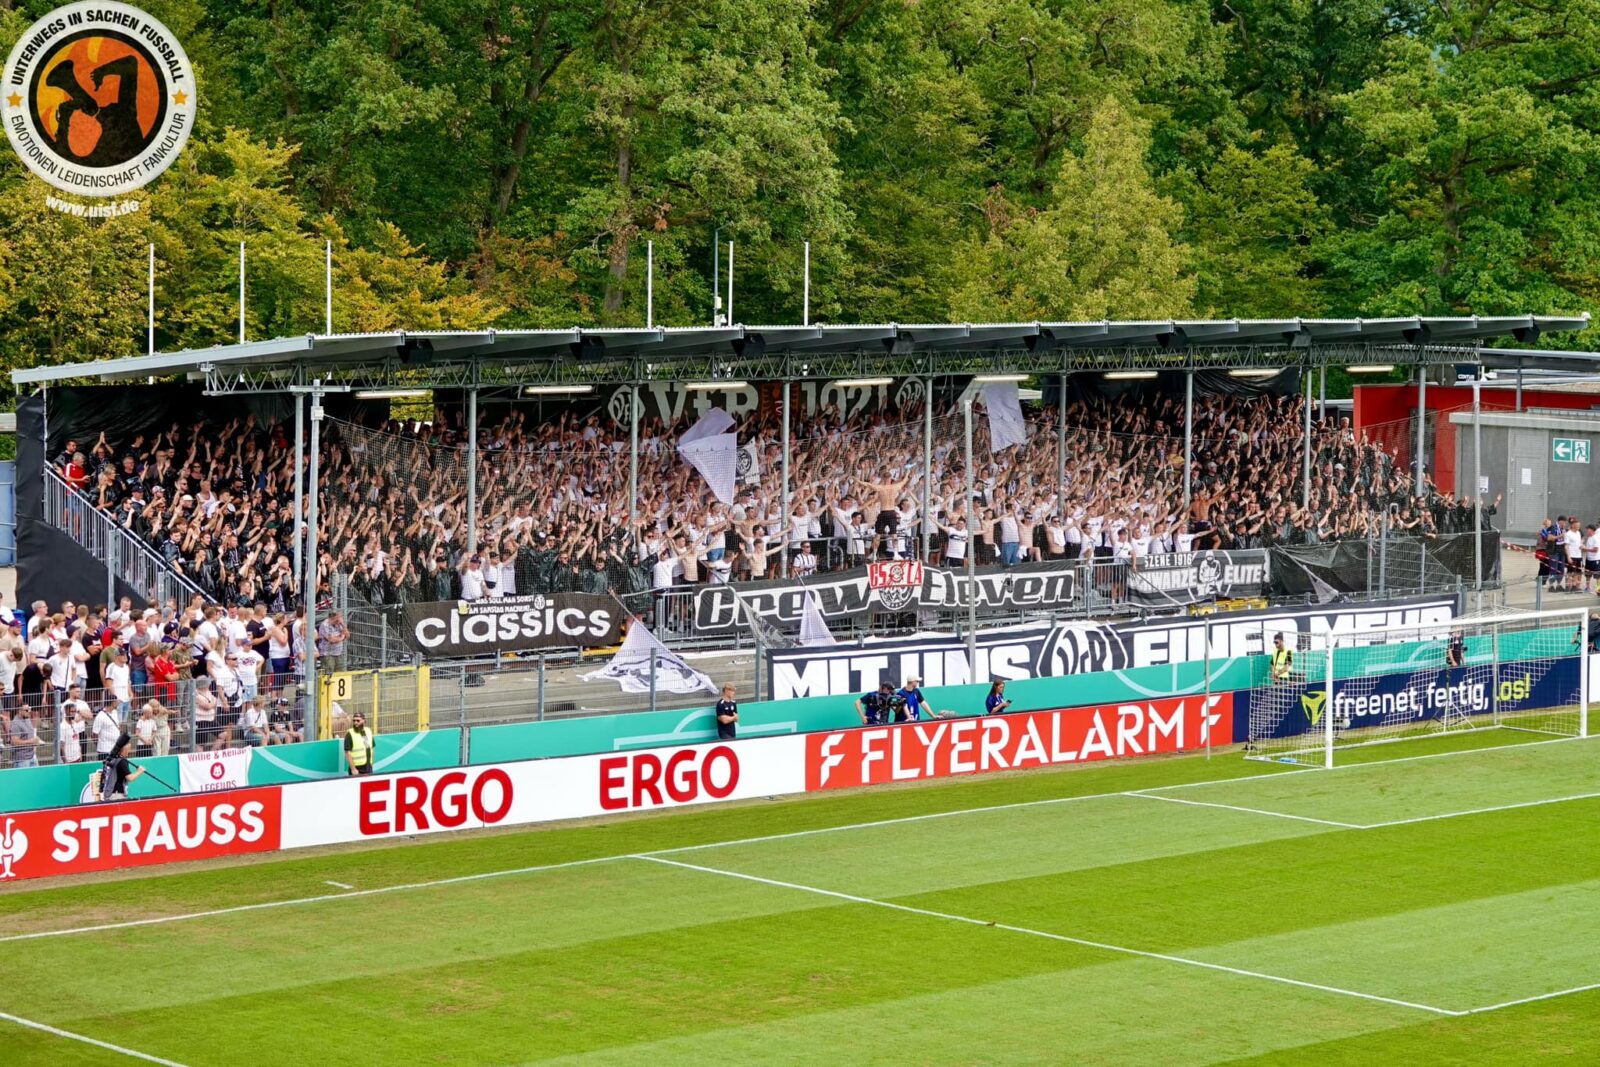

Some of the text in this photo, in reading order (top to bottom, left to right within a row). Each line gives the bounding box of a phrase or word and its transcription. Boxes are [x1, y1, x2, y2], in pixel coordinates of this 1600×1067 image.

[697, 567, 1074, 629] Crew Eleven
[1225, 564, 1263, 585] ELITE
[415, 599, 611, 648] classics
[338, 678, 346, 697] 8
[773, 655, 888, 700] MIT
[901, 644, 1031, 688] UNS
[1496, 672, 1531, 702] os!
[861, 700, 1185, 784] FLYERALARM
[359, 768, 514, 836] ERGO
[599, 746, 740, 810] ERGO
[51, 801, 265, 863] STRAUSS
